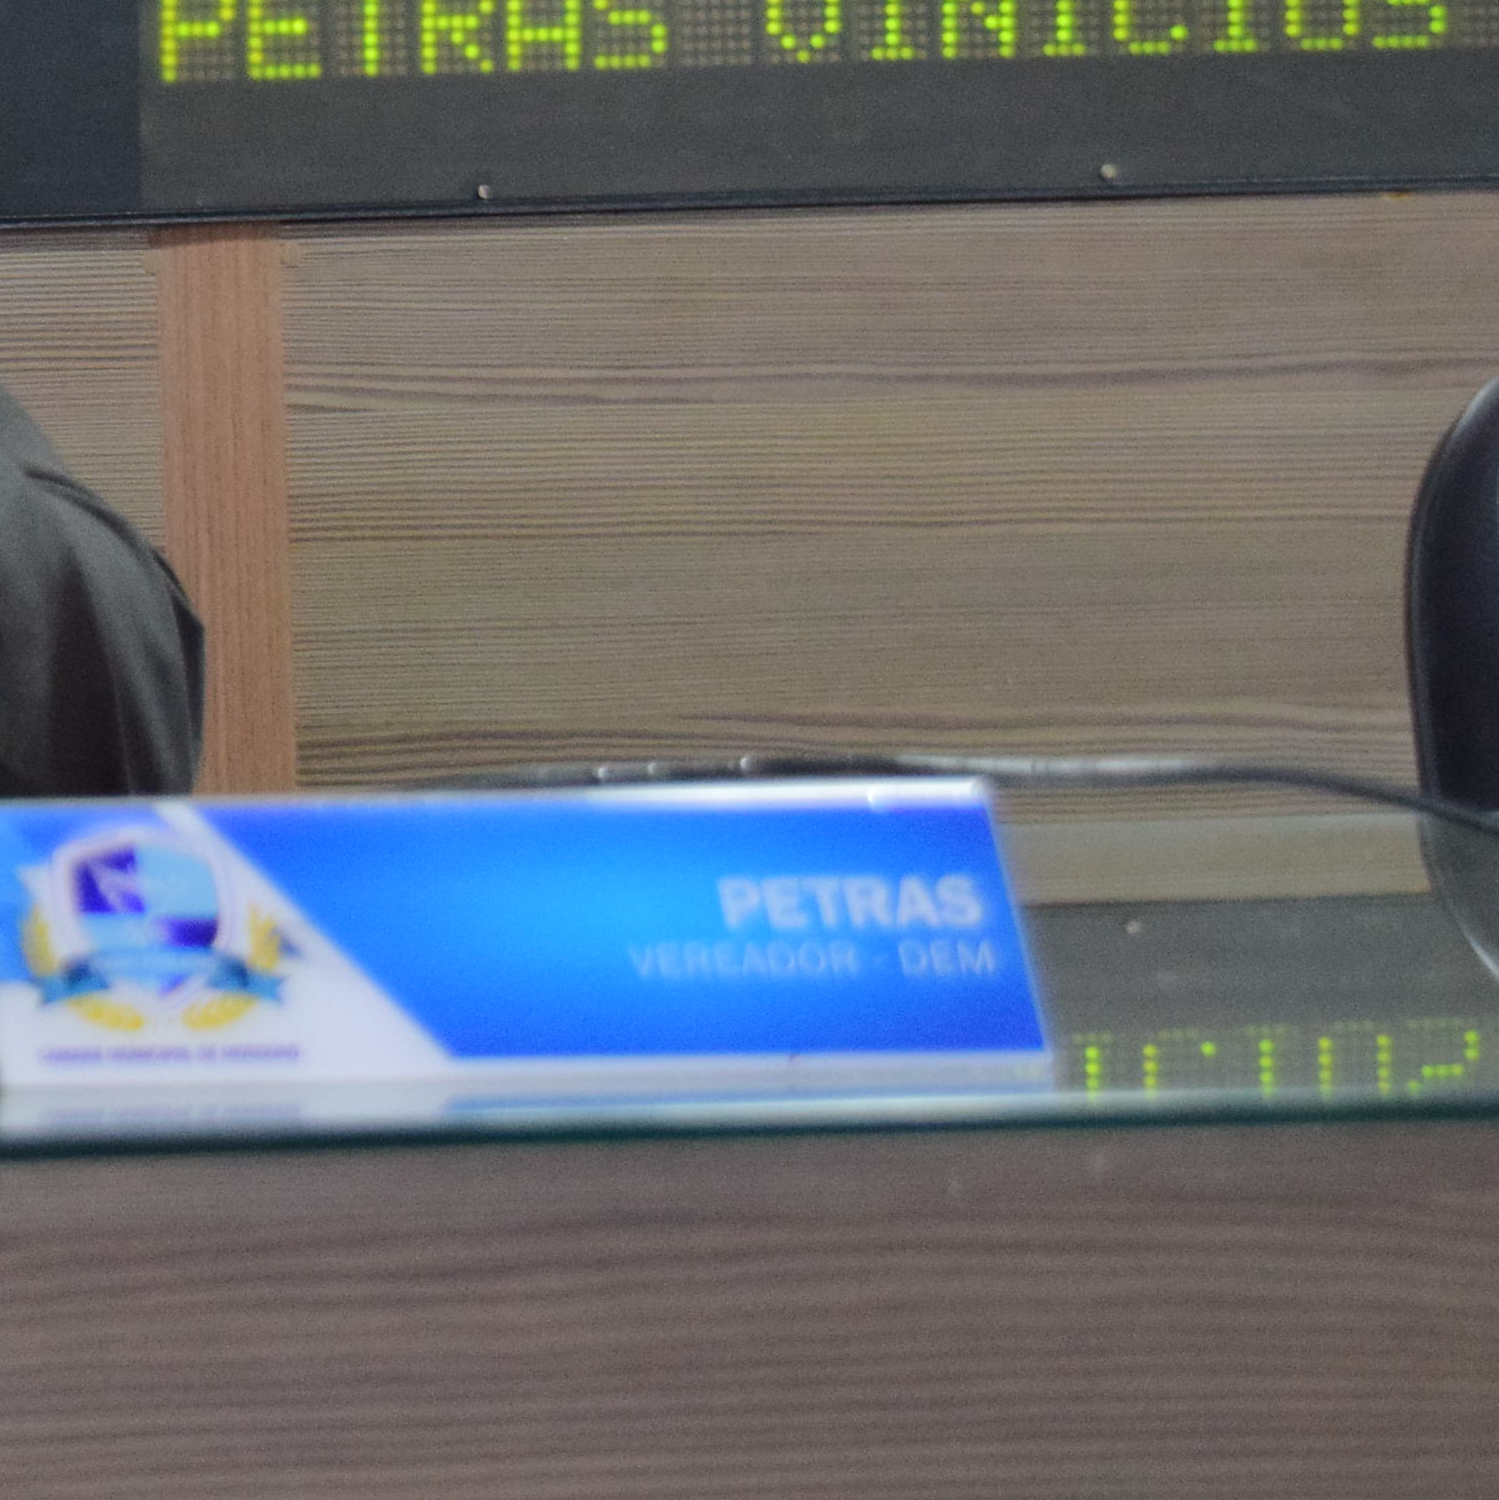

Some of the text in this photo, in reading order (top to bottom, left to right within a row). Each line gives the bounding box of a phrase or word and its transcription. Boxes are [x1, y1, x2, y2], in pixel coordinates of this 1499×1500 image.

[717, 873, 984, 930] PETRAS
[627, 938, 860, 980] VEREADOR
[897, 937, 996, 979] DEM
